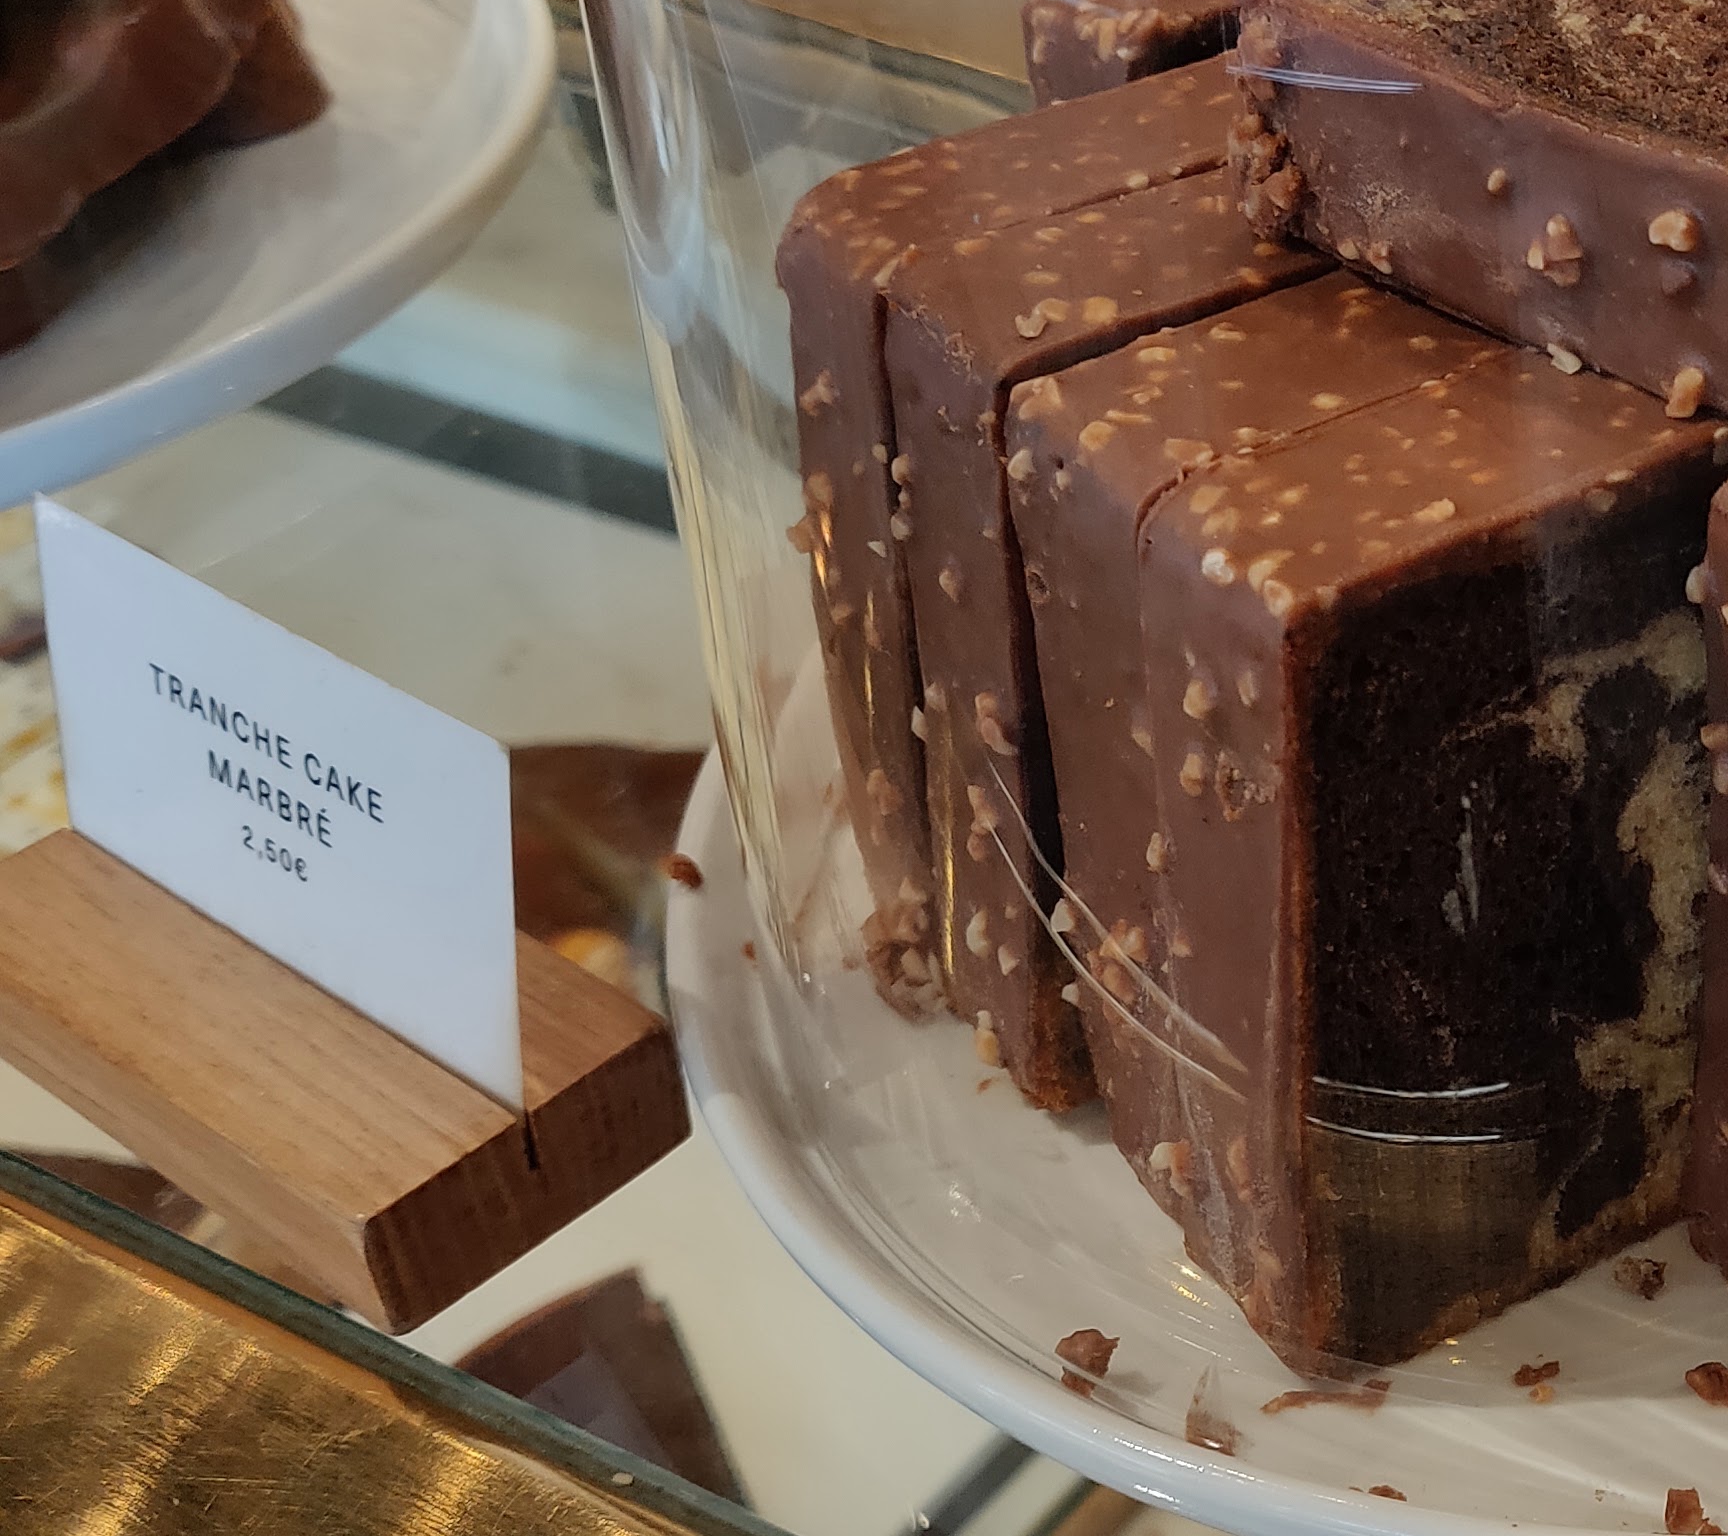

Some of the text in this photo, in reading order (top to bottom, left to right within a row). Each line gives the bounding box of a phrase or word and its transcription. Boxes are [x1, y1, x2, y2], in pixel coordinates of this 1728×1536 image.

[149, 662, 385, 824] TRANCHE CAKE
[208, 749, 333, 849] MARBRÉ
[241, 824, 308, 882] 2,50€
